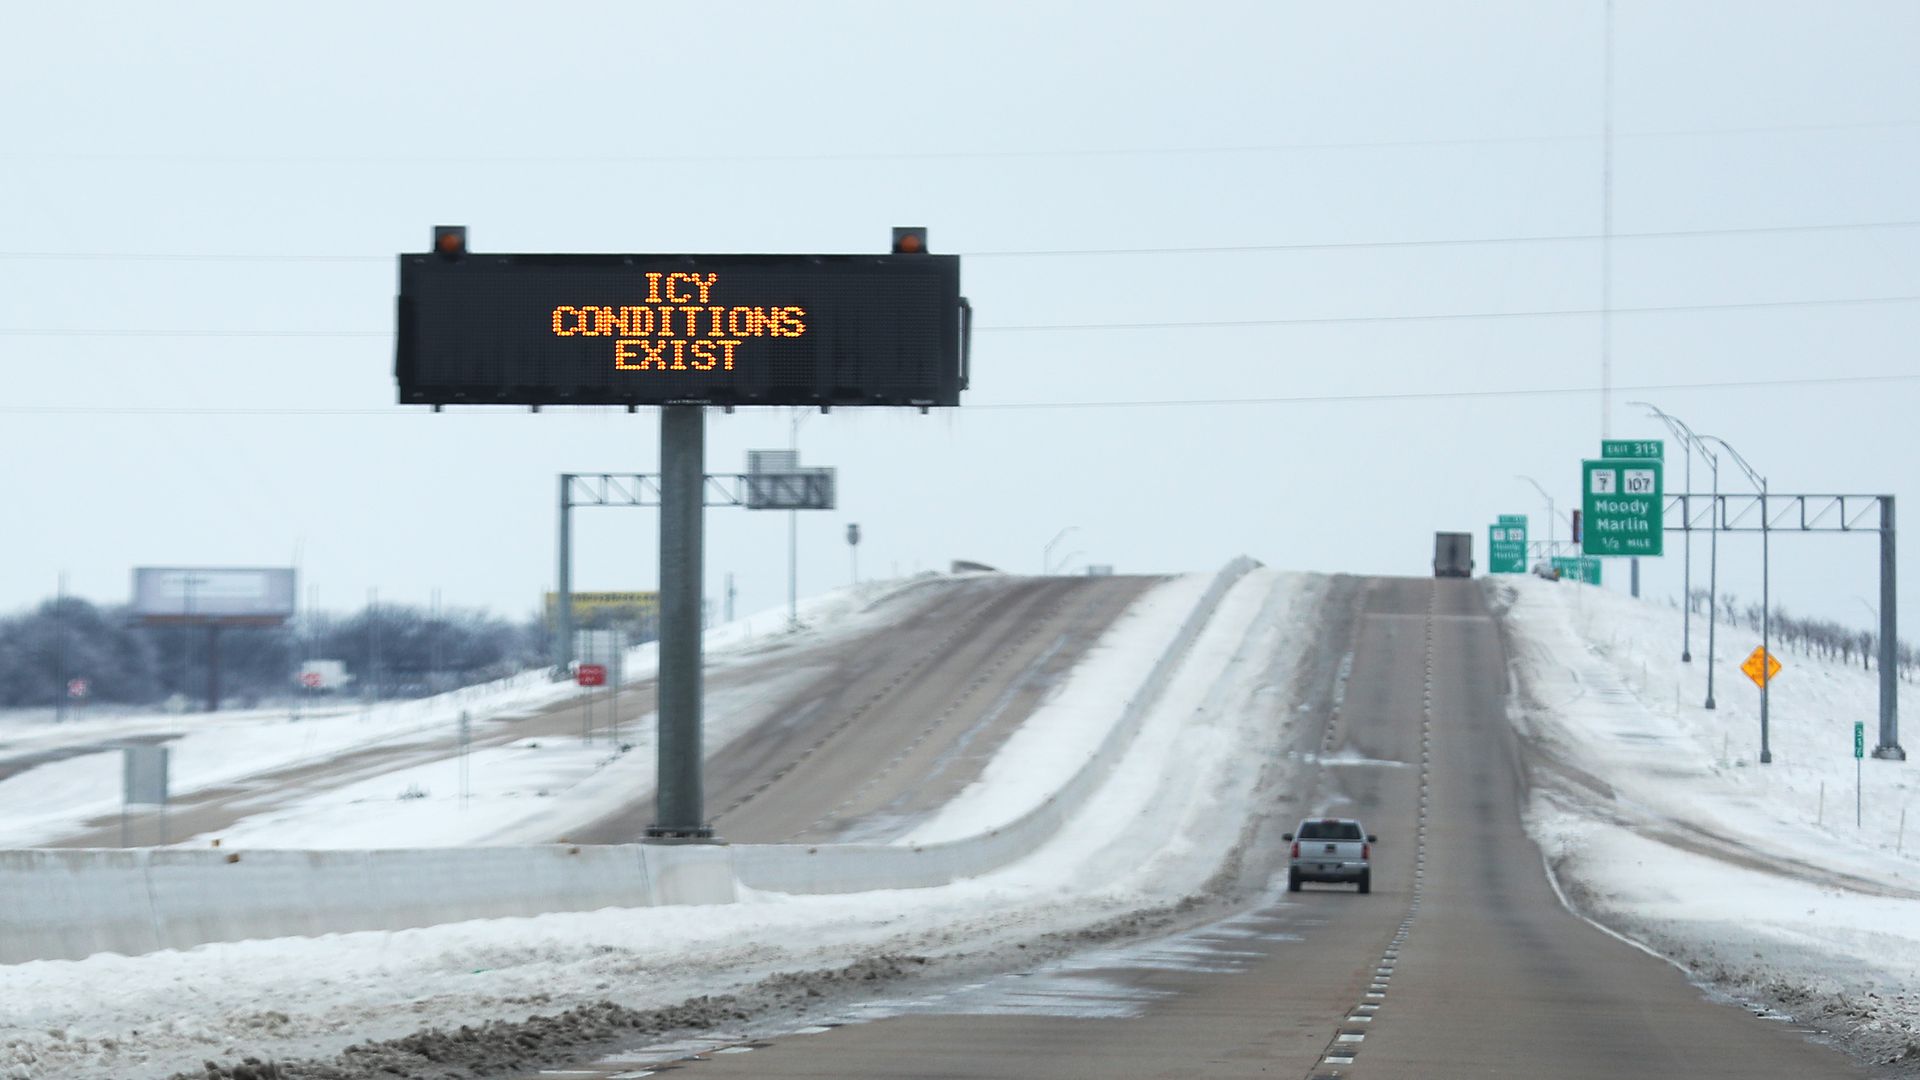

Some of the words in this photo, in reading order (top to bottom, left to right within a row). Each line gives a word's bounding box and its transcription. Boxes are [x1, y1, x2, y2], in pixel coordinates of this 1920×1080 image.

[644, 272, 718, 304] ICY
[551, 305, 807, 338] CONDITIONS
[614, 339, 742, 371] EXIST
[1634, 443, 1658, 454] 315
[1599, 477, 1608, 491] 7
[1627, 477, 1651, 492] 107
[1595, 500, 1649, 515] Moody
[1597, 517, 1649, 531] Marlin
[1627, 538, 1651, 548] MILE
